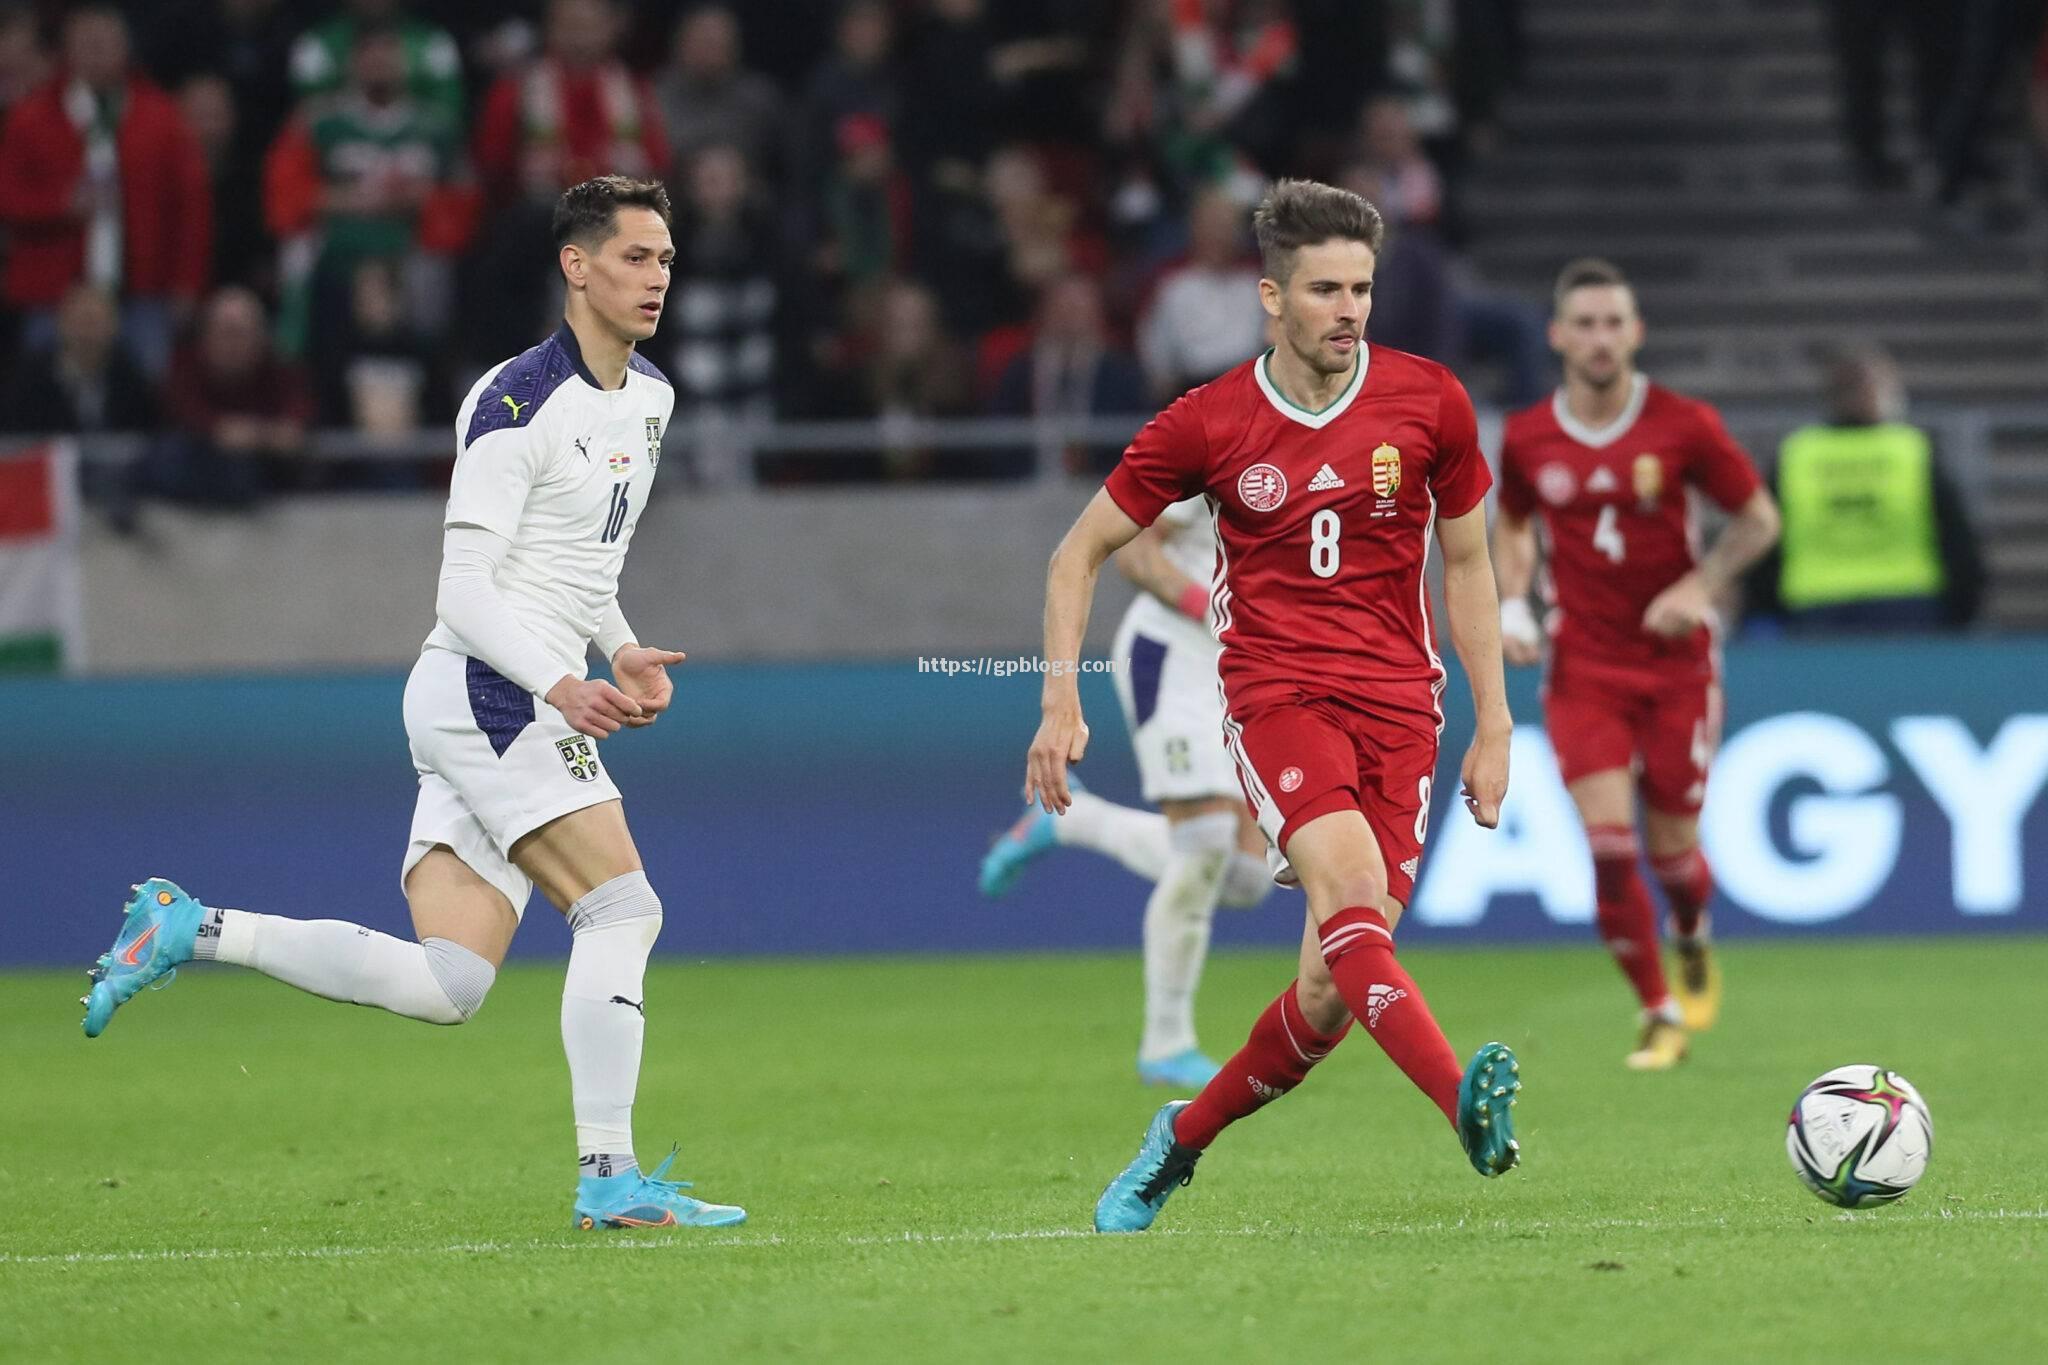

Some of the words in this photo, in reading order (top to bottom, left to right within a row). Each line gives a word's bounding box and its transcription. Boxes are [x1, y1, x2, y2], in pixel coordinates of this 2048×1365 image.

[601, 481, 630, 543] 16
[1307, 479, 1345, 492] adidas
[1310, 509, 1340, 578] 8
[1593, 504, 1626, 565] 4
[1414, 775, 1431, 845] 8
[1369, 989, 1408, 1028] adidas
